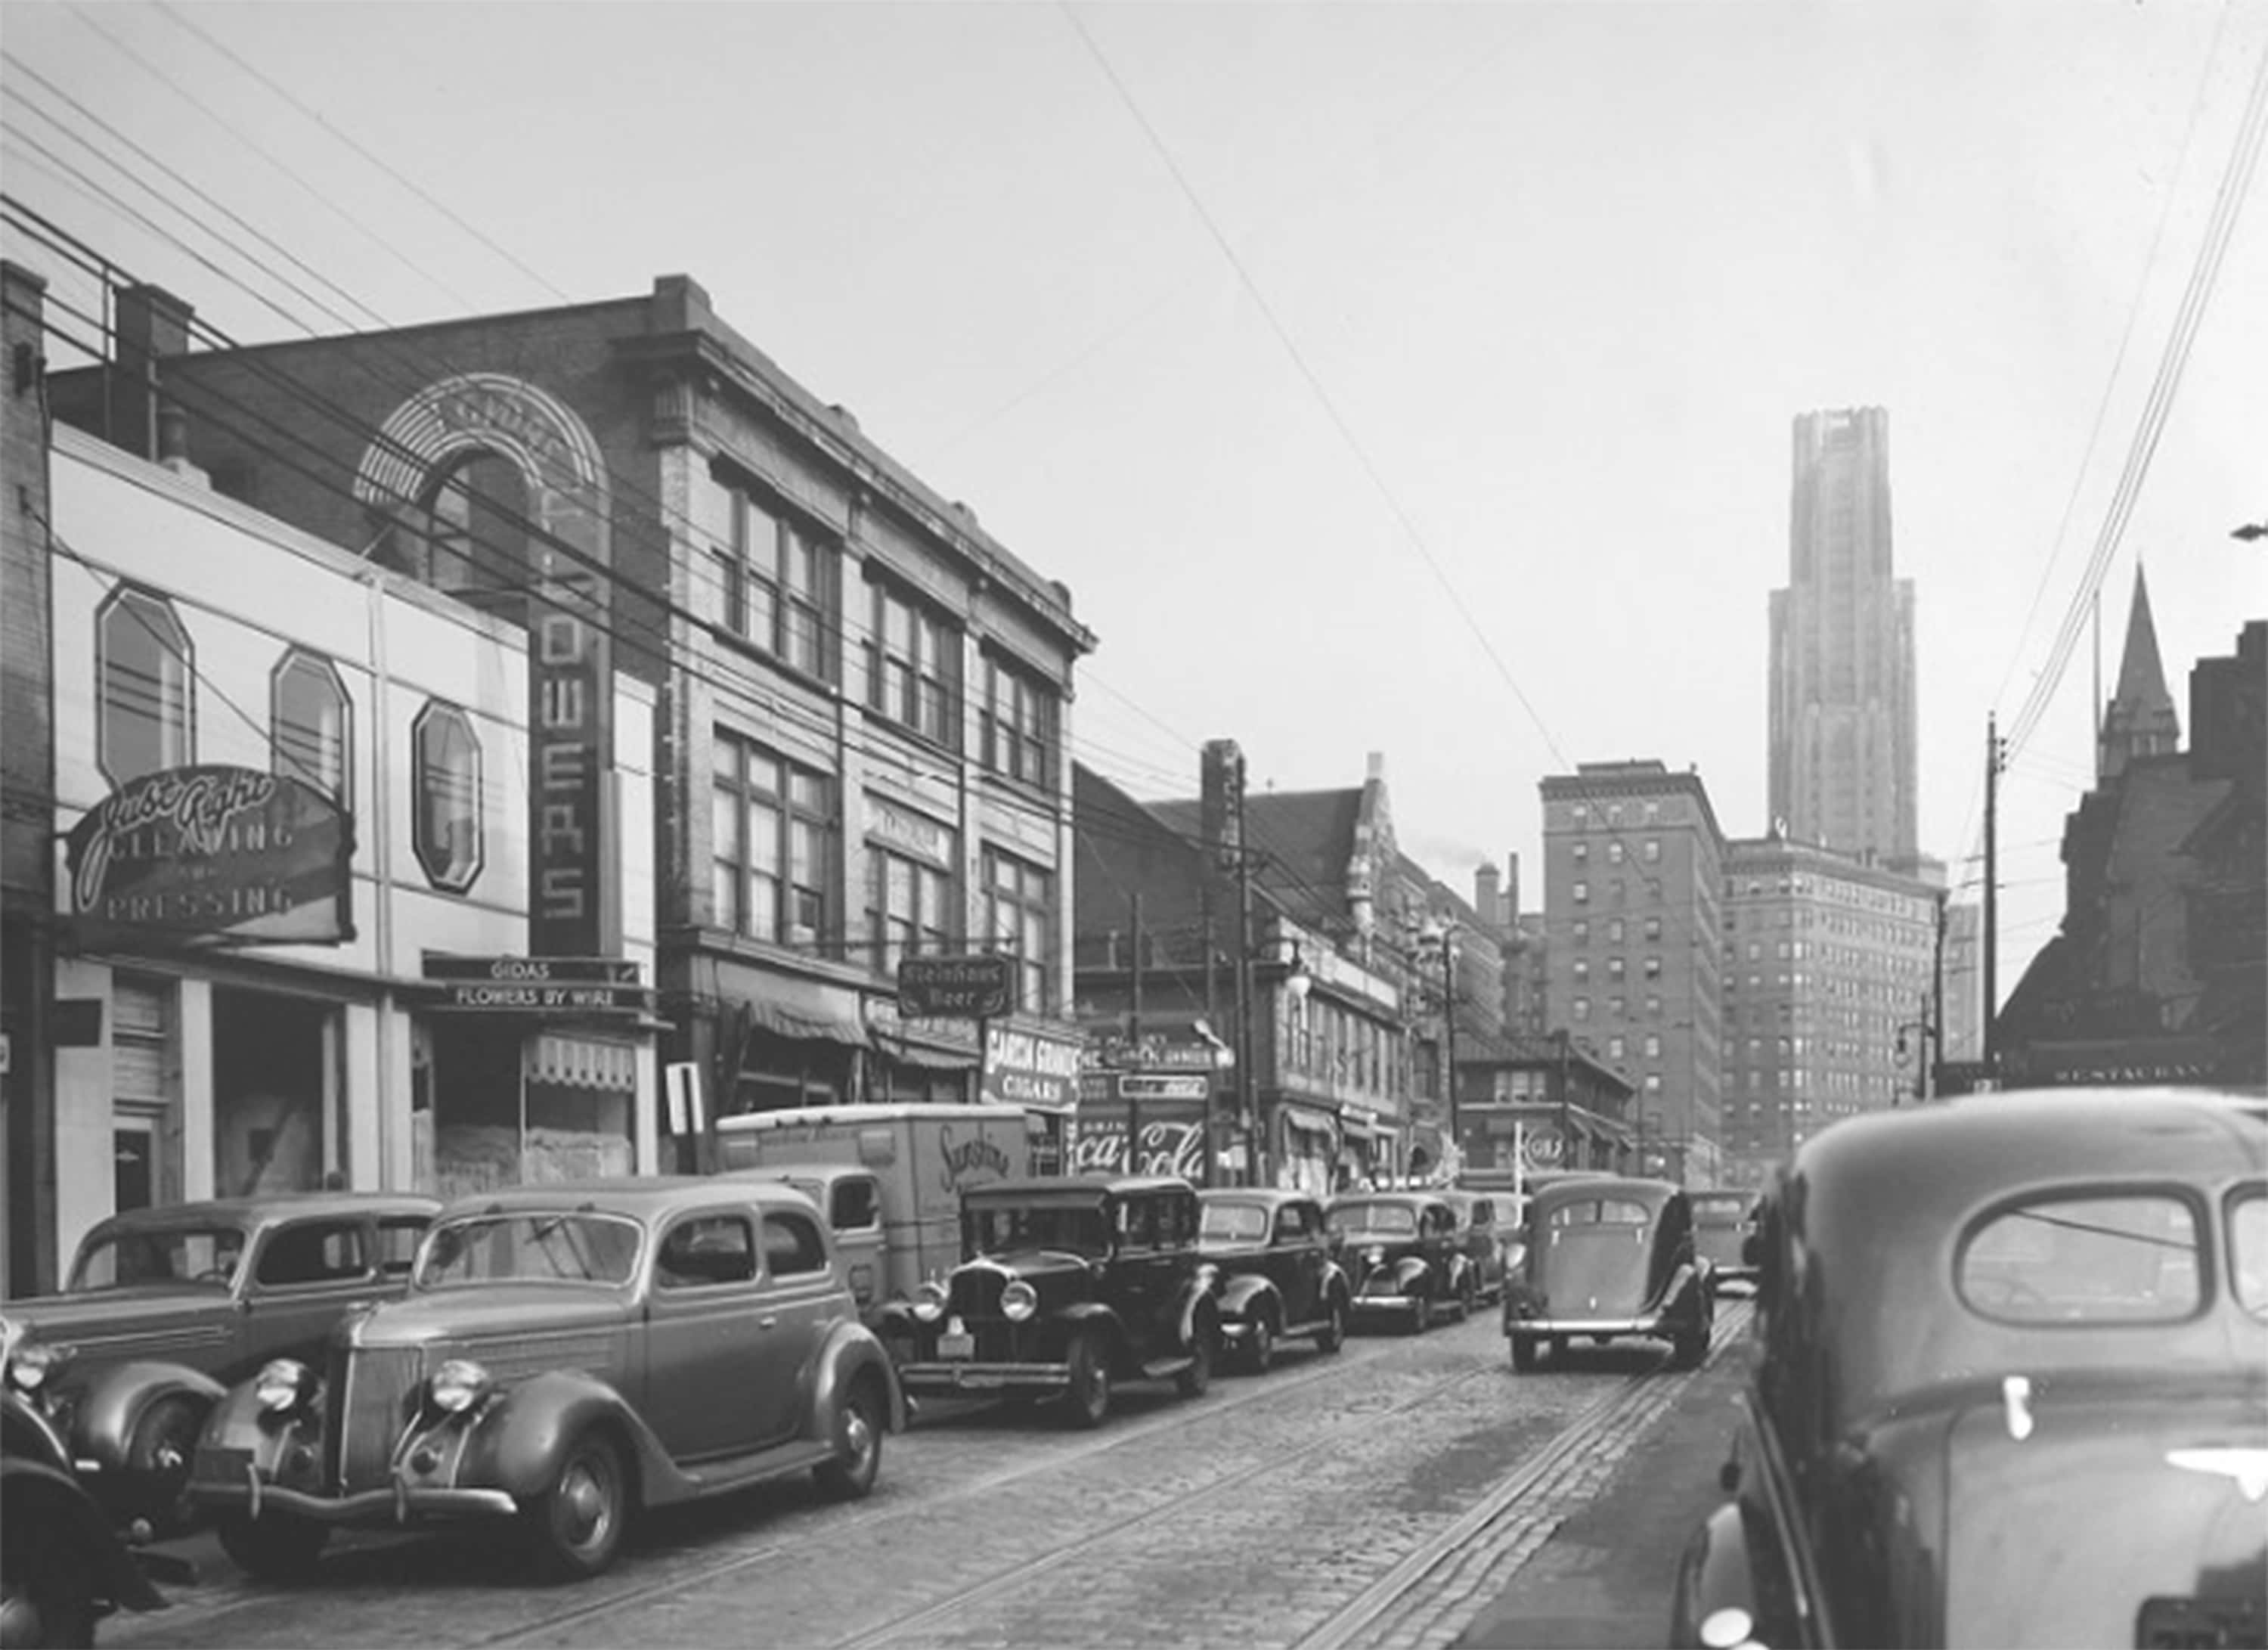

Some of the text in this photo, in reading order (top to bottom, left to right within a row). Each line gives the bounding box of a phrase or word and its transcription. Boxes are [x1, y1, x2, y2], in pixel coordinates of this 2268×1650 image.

[540, 488, 584, 919] FLOWERS
[109, 822, 293, 860] CLEANING
[107, 886, 293, 920] PRESSING
[491, 961, 550, 980] GIDAS
[457, 988, 614, 1006] FLOWERS BY WIRE
